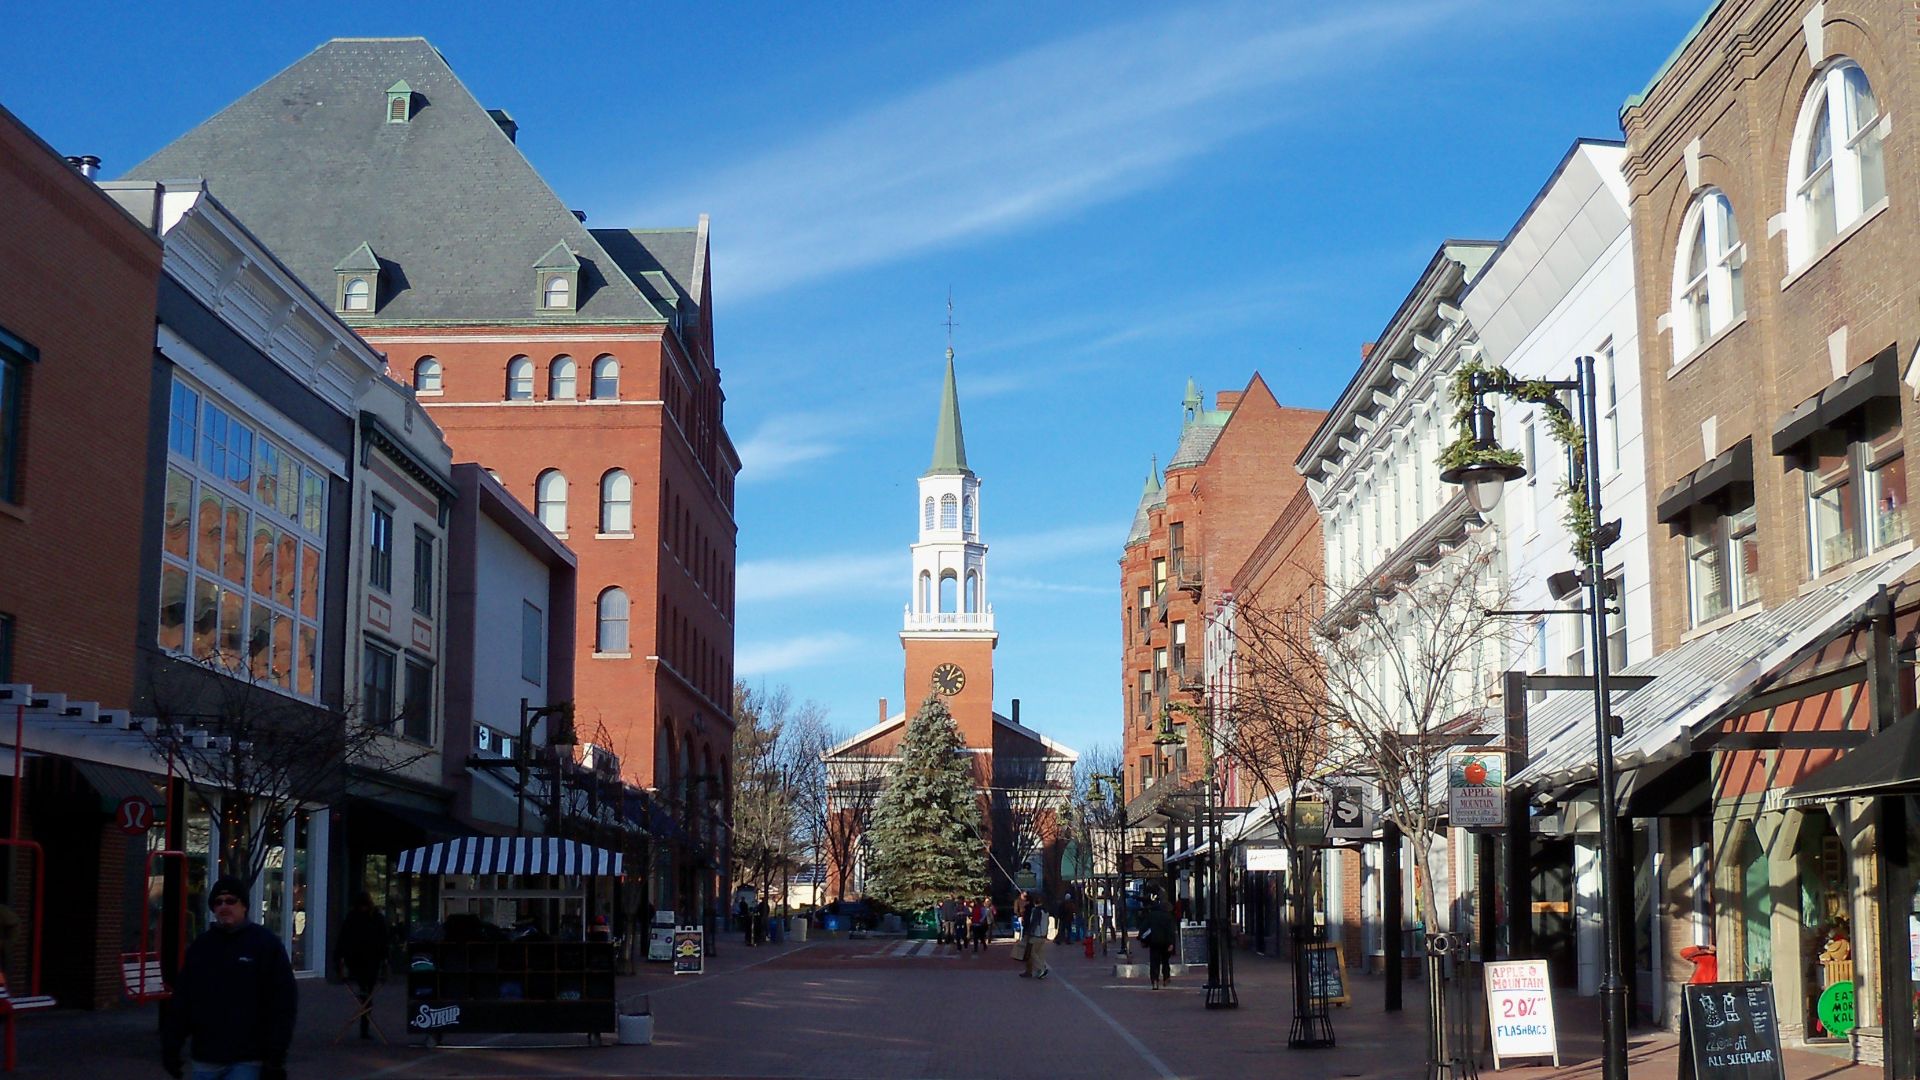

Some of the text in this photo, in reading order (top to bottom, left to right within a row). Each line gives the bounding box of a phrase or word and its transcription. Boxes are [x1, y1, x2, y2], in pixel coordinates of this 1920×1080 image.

[1461, 788, 1493, 797] APPLE
[1460, 799, 1494, 808] MOUNTAIN
[1492, 967, 1525, 978] APPLE
[1492, 977, 1544, 989] MOUNTAIN
[1502, 997, 1537, 1018] 20%
[1832, 1001, 1854, 1012] MOR
[1833, 1012, 1854, 1023] KAL
[1734, 1034, 1747, 1050] off
[1708, 1049, 1774, 1068] ALL SLEEPWEAR
